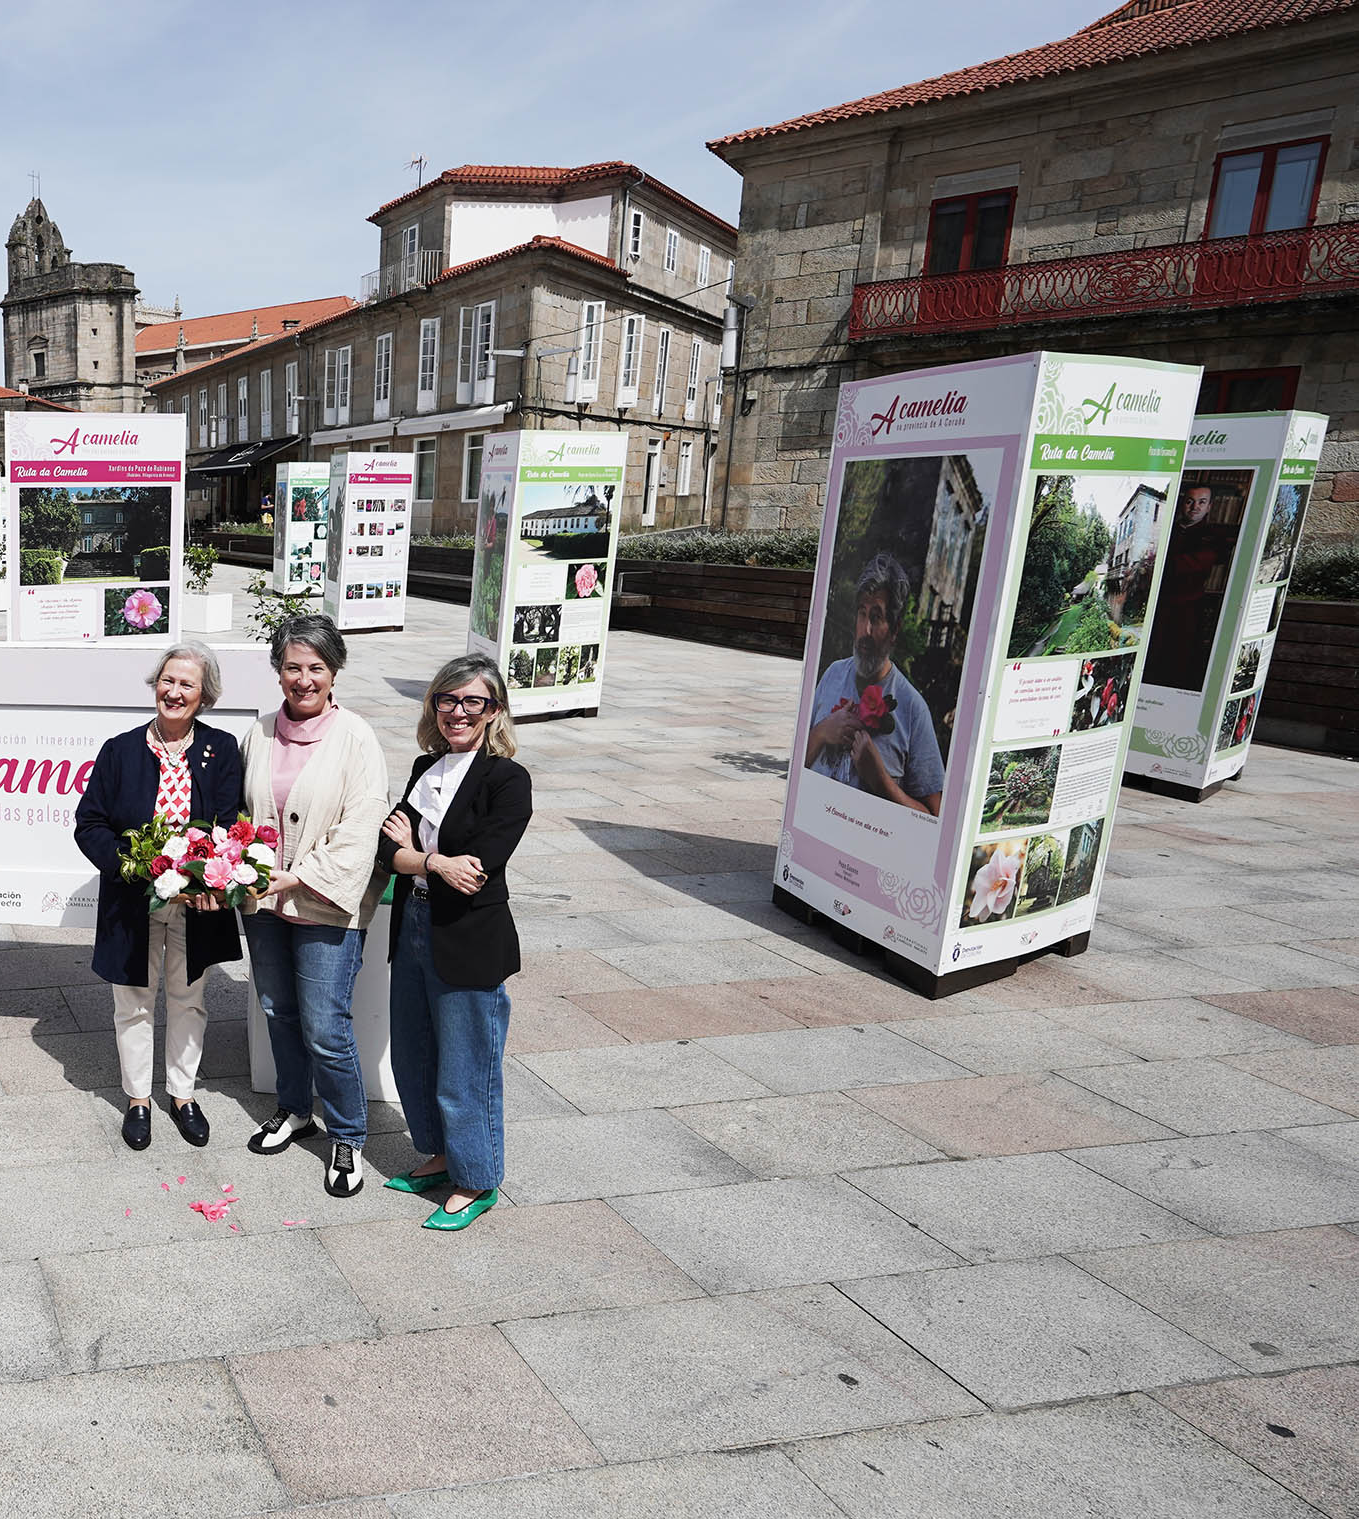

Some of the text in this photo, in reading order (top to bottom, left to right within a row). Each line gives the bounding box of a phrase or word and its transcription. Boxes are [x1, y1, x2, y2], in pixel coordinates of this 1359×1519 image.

[1082, 382, 1161, 425] A camelia
[871, 390, 968, 436] A camelia
[903, 421, 928, 431] provincia
[49, 427, 139, 455] A camelia
[547, 442, 600, 462] A camelia
[1040, 443, 1115, 461] Ruta da Camelia
[14, 465, 88, 478] Ruta da Camelia
[364, 459, 375, 471] A
[35, 734, 95, 747] itinerante
